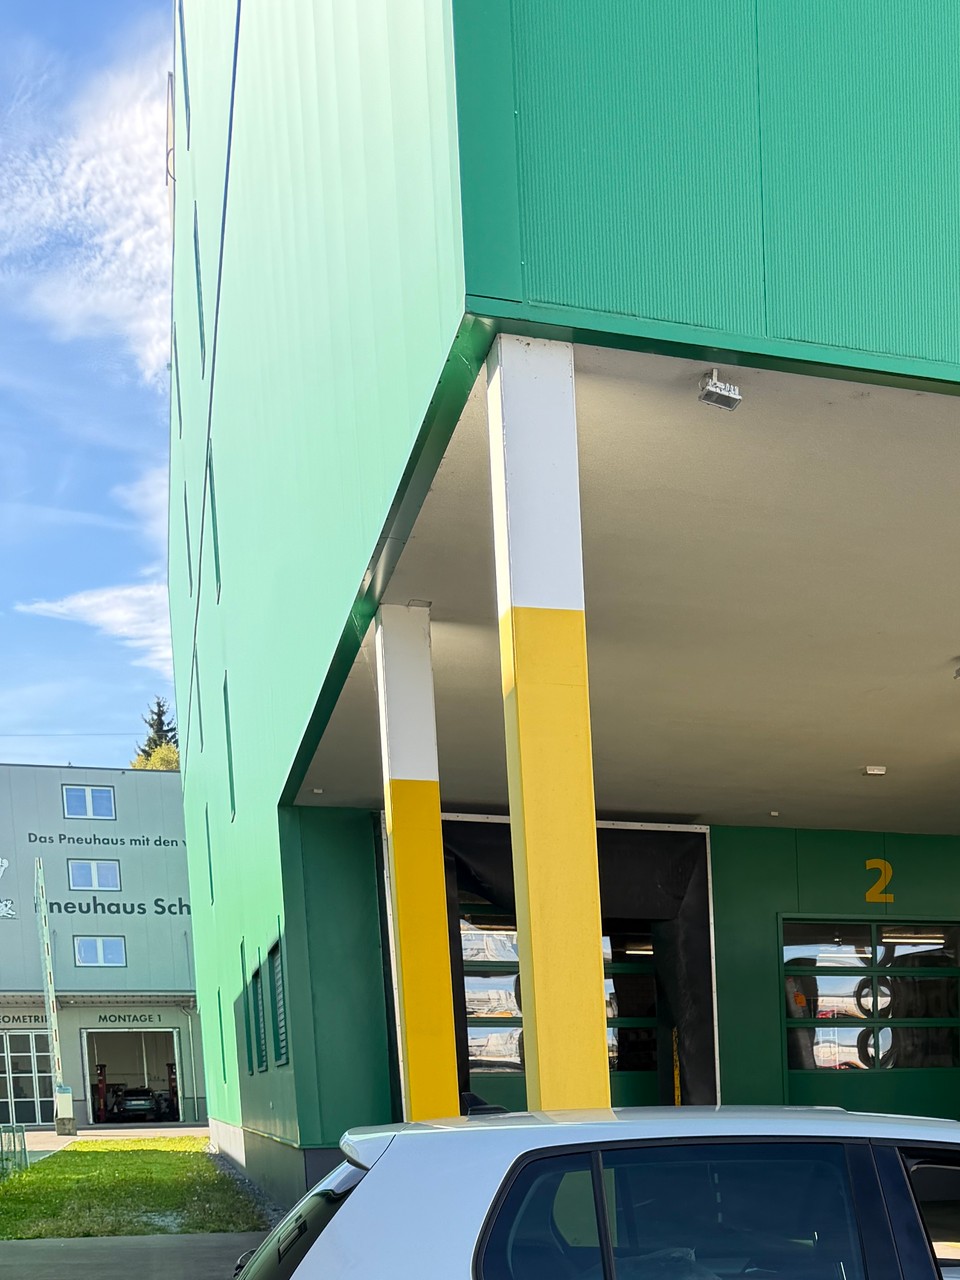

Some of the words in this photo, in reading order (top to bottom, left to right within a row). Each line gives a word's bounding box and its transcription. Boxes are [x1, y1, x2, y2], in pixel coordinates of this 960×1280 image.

[28, 833, 54, 844] Das
[58, 834, 126, 846] Pneuhaus
[130, 835, 150, 846] mit
[154, 836, 178, 847] den
[865, 858, 894, 903] 2
[98, 1014, 153, 1023] MONTAGE
[157, 1014, 162, 1023] 1
